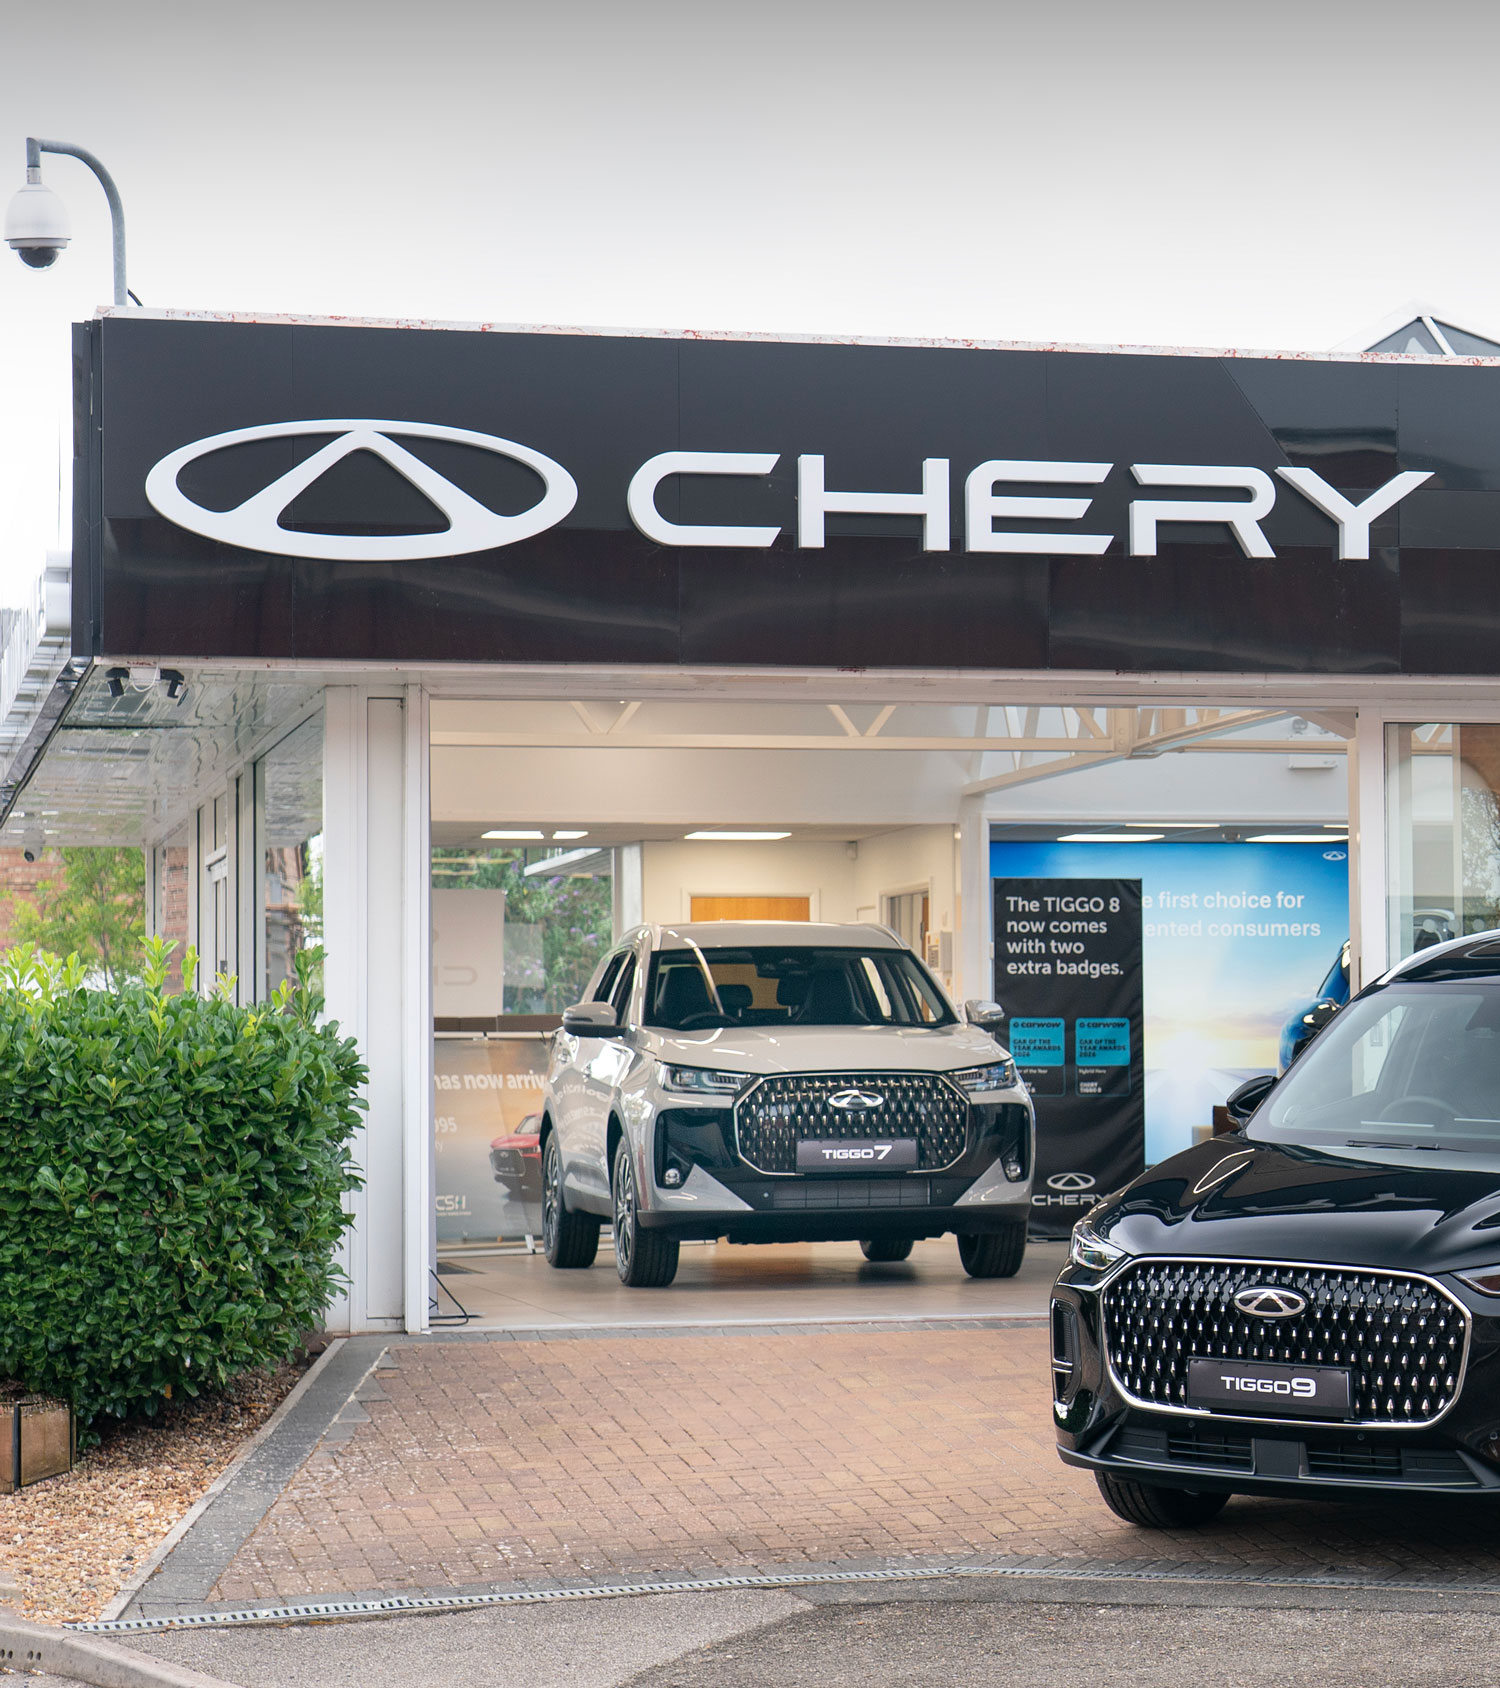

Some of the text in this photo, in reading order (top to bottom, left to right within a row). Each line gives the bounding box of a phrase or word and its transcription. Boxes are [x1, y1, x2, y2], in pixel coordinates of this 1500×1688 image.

[627, 450, 1436, 560] CHERY
[1006, 897, 1120, 913] The TIGGO 8
[1158, 891, 1198, 908] first
[1203, 891, 1271, 908] choice
[1276, 891, 1304, 908] for
[1006, 921, 1107, 933] now comes
[1207, 922, 1321, 937] consumers
[1006, 938, 1085, 954] with two
[1006, 960, 1124, 979] extra badges.
[464, 1072, 503, 1090] now
